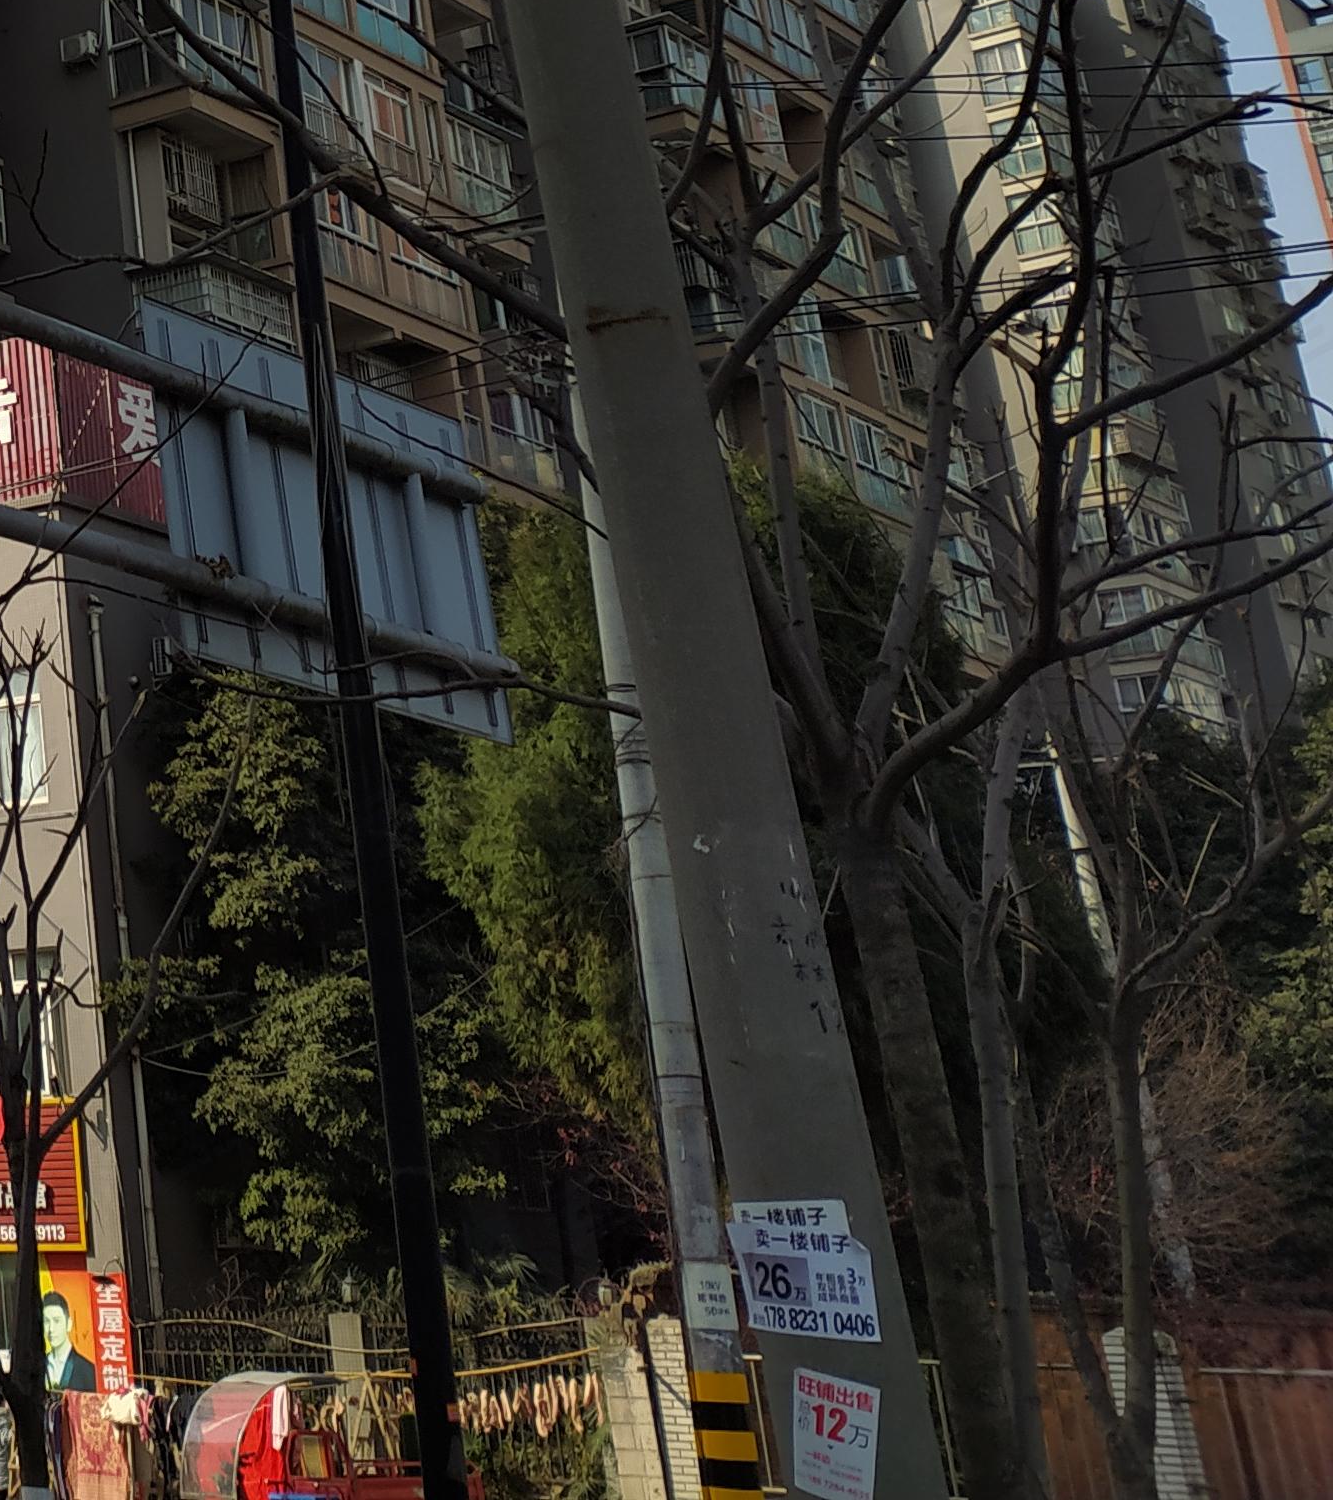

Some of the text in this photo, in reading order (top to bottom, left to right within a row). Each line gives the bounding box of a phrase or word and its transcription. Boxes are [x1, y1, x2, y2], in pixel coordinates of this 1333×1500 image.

[756, 1229, 850, 1254] 卖一楼铺子
[95, 1284, 129, 1391] 全屋定制
[764, 1305, 787, 1329] 178
[789, 1308, 829, 1333] 8231
[833, 1311, 876, 1337] 0406
[799, 1375, 873, 1413] 旺铺出售
